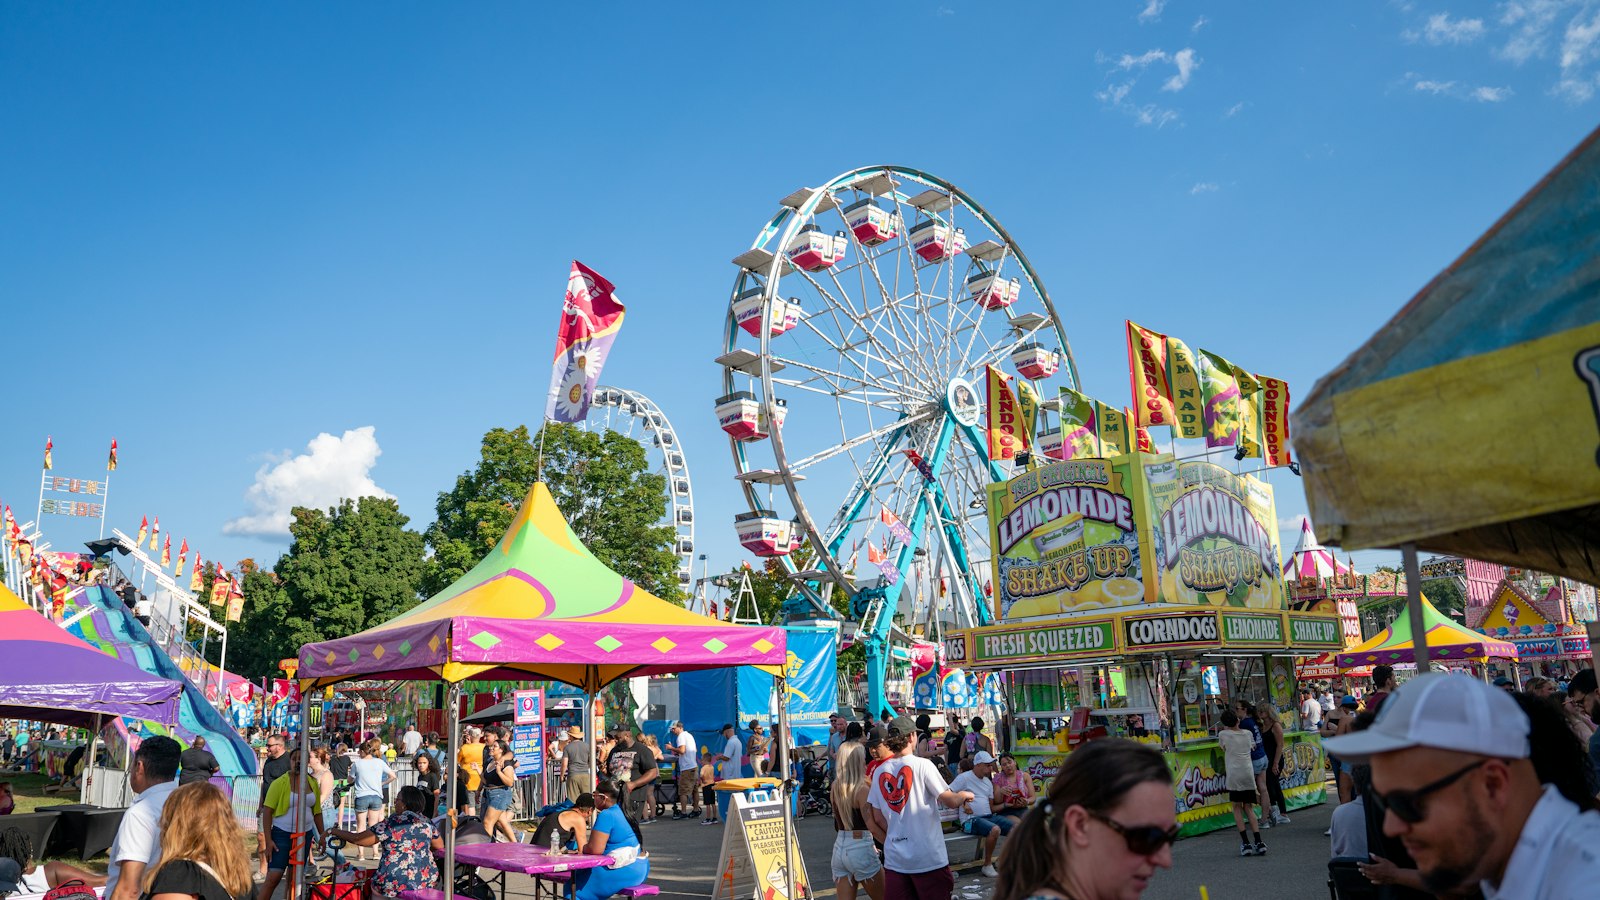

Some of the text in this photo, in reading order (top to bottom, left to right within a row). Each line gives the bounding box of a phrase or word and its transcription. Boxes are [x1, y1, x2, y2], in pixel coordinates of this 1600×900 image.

[1139, 329, 1163, 424] CORNDOGS
[1264, 379, 1279, 465] CORNDOGS
[52, 477, 98, 494] FUN
[1012, 472, 1038, 502] THE
[43, 500, 100, 518] SLIDE
[999, 487, 1133, 554] LEMONADE
[1162, 488, 1273, 578] LEMONADE
[1045, 542, 1082, 561] LEMONADE
[1007, 545, 1132, 597] SHAKE UP
[1181, 546, 1262, 593] SHAKE UP
[984, 626, 1104, 657] FRESH SQUEEZED
[1130, 617, 1217, 644] CORNDOGS
[1226, 617, 1280, 640] LEMONADE
[1294, 622, 1335, 641] SHAKE UP
[1516, 641, 1555, 654] CANDY
[754, 826, 785, 836] CAUTION
[753, 841, 774, 849] PLEASE
